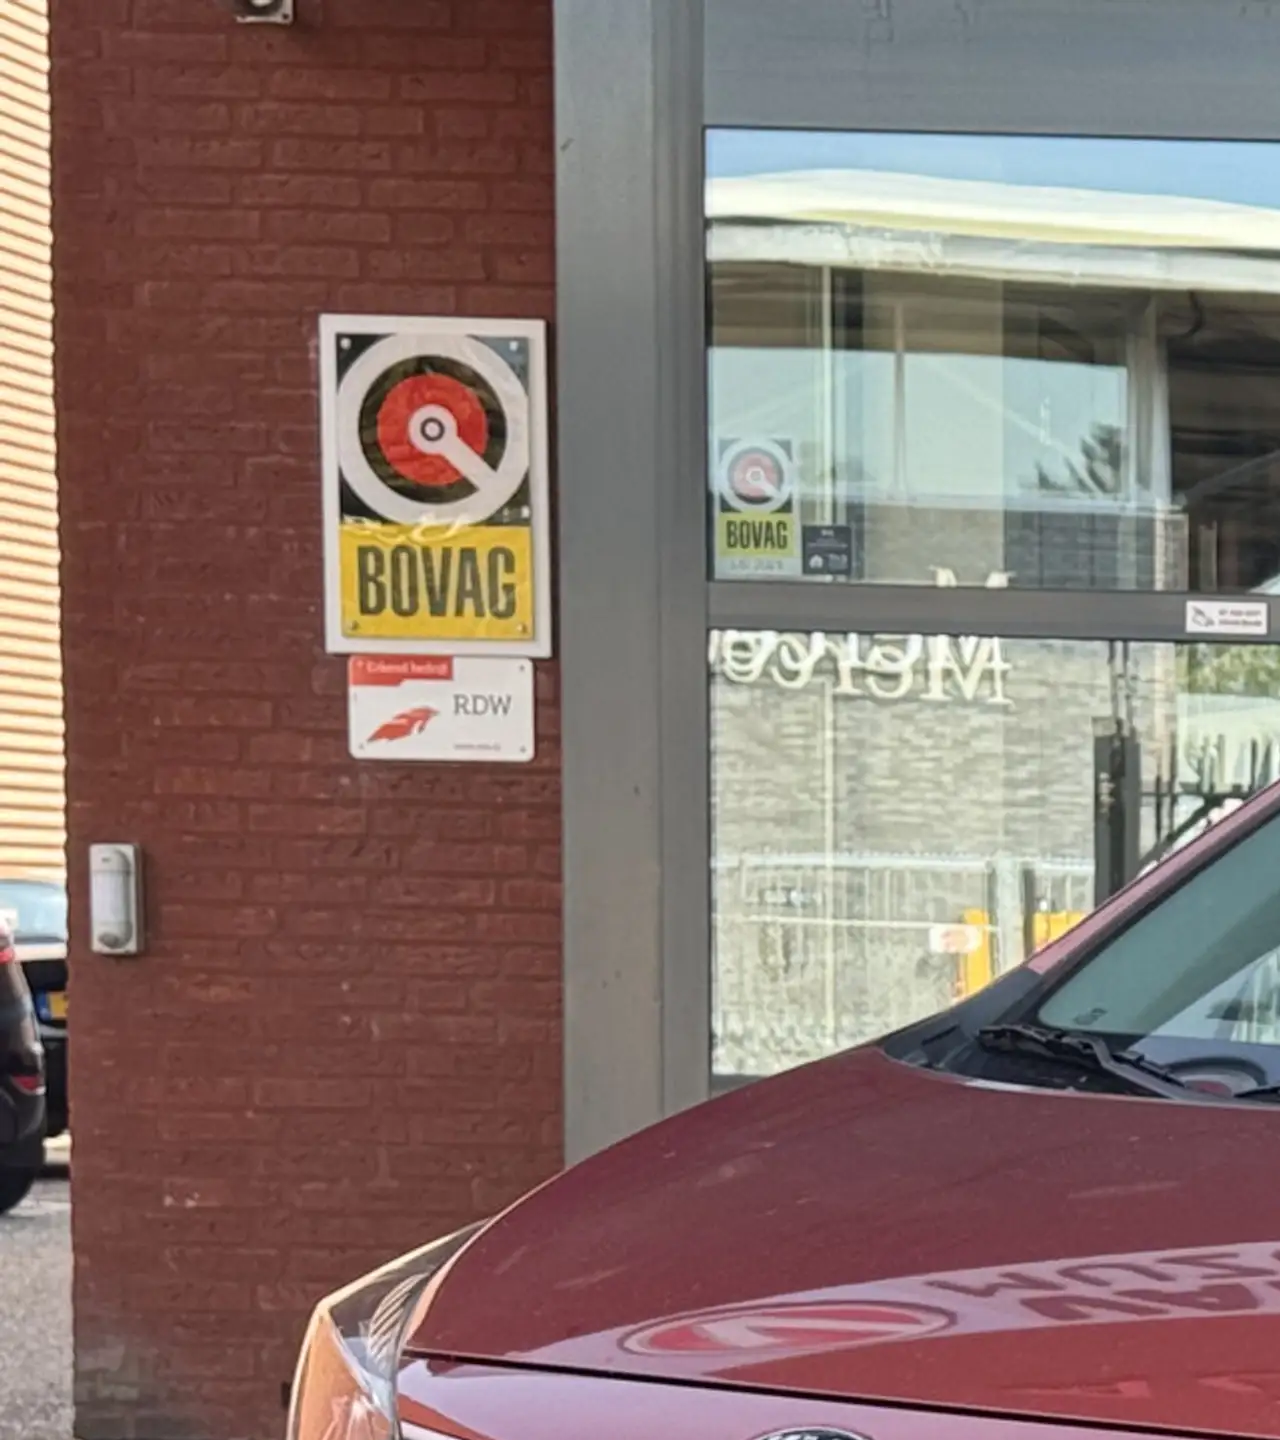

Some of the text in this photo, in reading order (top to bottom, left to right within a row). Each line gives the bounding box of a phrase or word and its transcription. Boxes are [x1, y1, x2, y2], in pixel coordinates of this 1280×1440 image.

[726, 520, 788, 550] BOVAG
[356, 543, 517, 620] BOVAG
[453, 693, 512, 716] RDW
